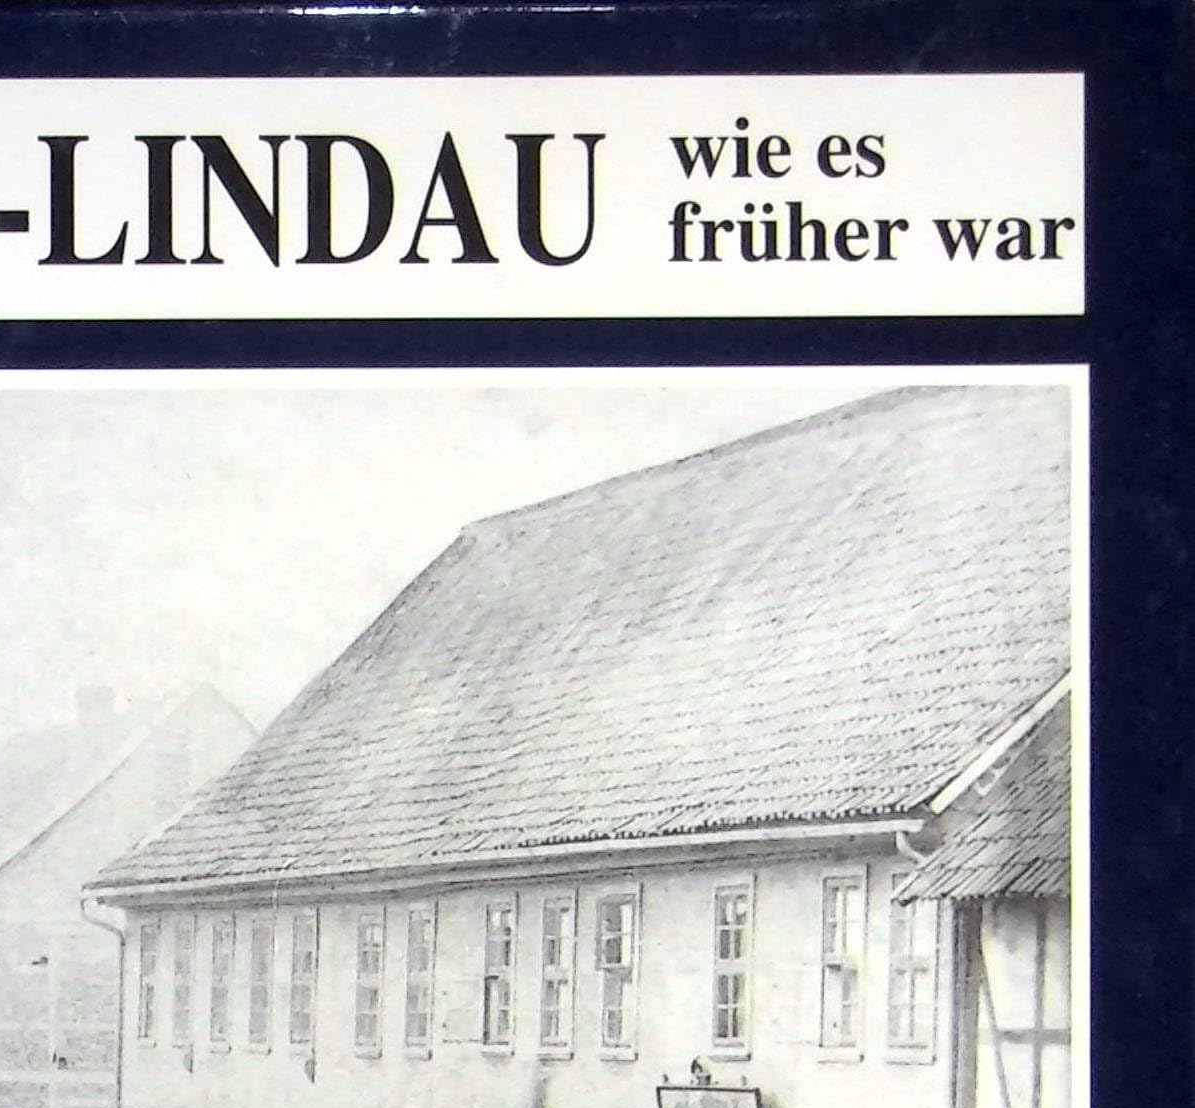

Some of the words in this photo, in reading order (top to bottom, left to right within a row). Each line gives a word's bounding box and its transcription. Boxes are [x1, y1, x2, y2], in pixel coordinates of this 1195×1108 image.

[670, 116, 793, 179] wie
[817, 134, 886, 179] es
[669, 200, 910, 263] früher
[932, 217, 1076, 261] war
